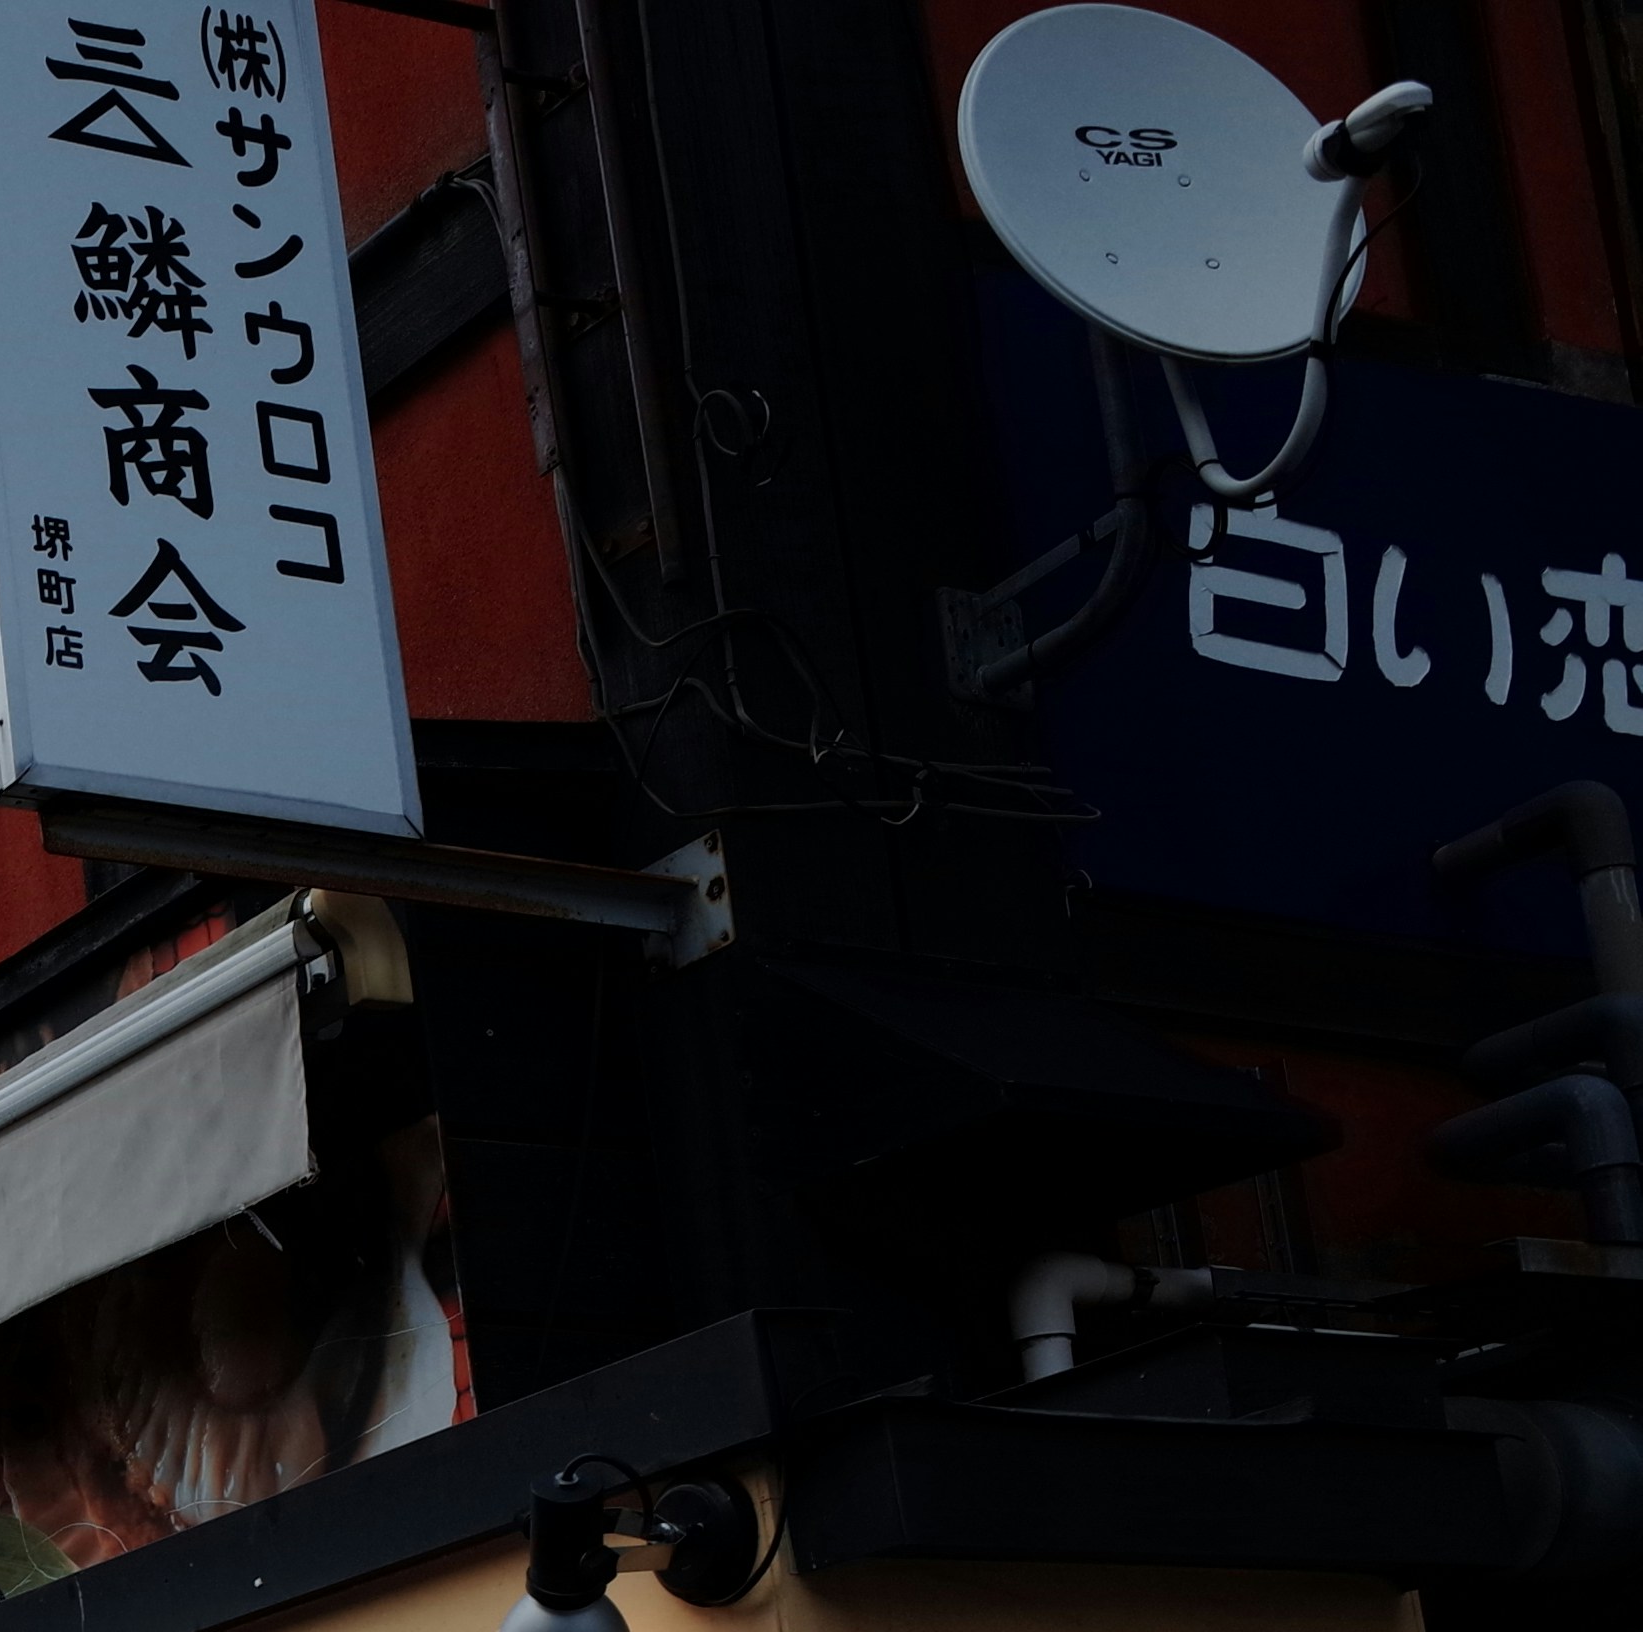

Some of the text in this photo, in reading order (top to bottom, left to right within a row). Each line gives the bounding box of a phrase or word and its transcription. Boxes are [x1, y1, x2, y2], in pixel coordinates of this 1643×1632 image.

[1075, 125, 1178, 152] CS
[1096, 149, 1164, 168] YAGI
[30, 513, 84, 670] 堺町店
